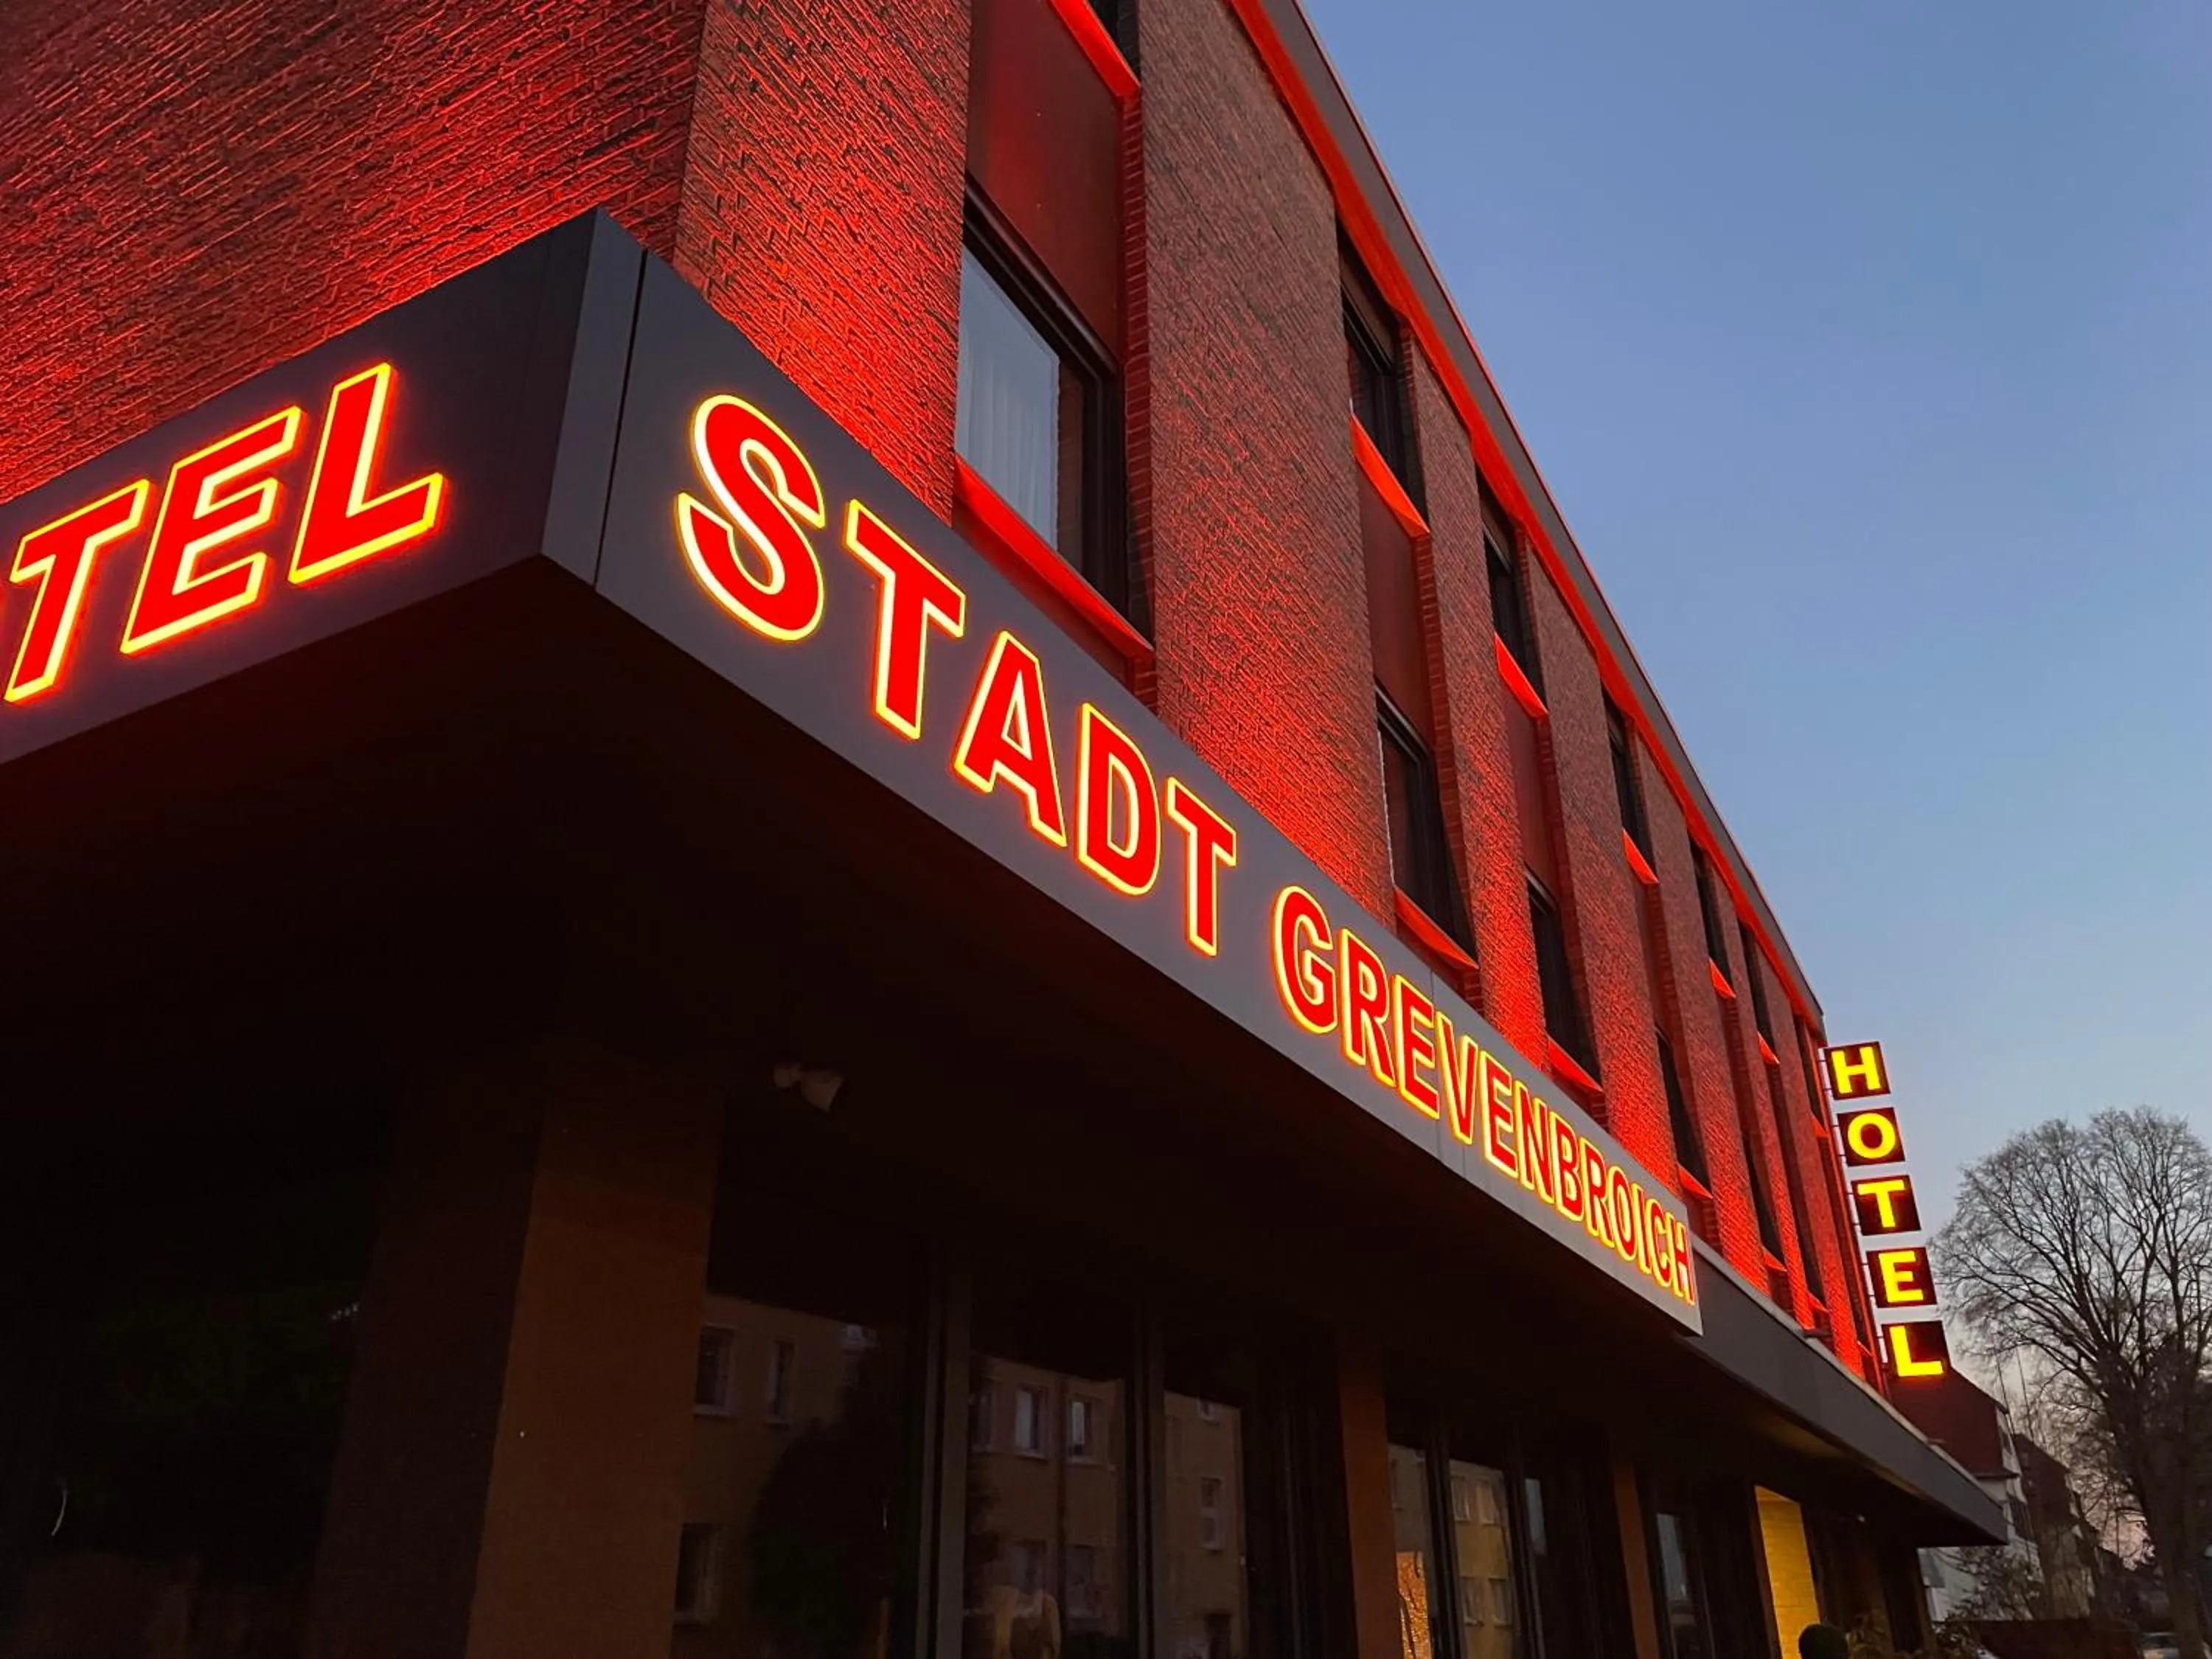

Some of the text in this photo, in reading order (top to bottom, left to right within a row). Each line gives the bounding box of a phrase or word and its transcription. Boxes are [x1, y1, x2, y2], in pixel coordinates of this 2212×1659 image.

[4, 362, 444, 703] TEL
[677, 394, 1695, 1304] STADT GREVENBROICH
[1832, 1046, 1944, 1377] HOTEL
